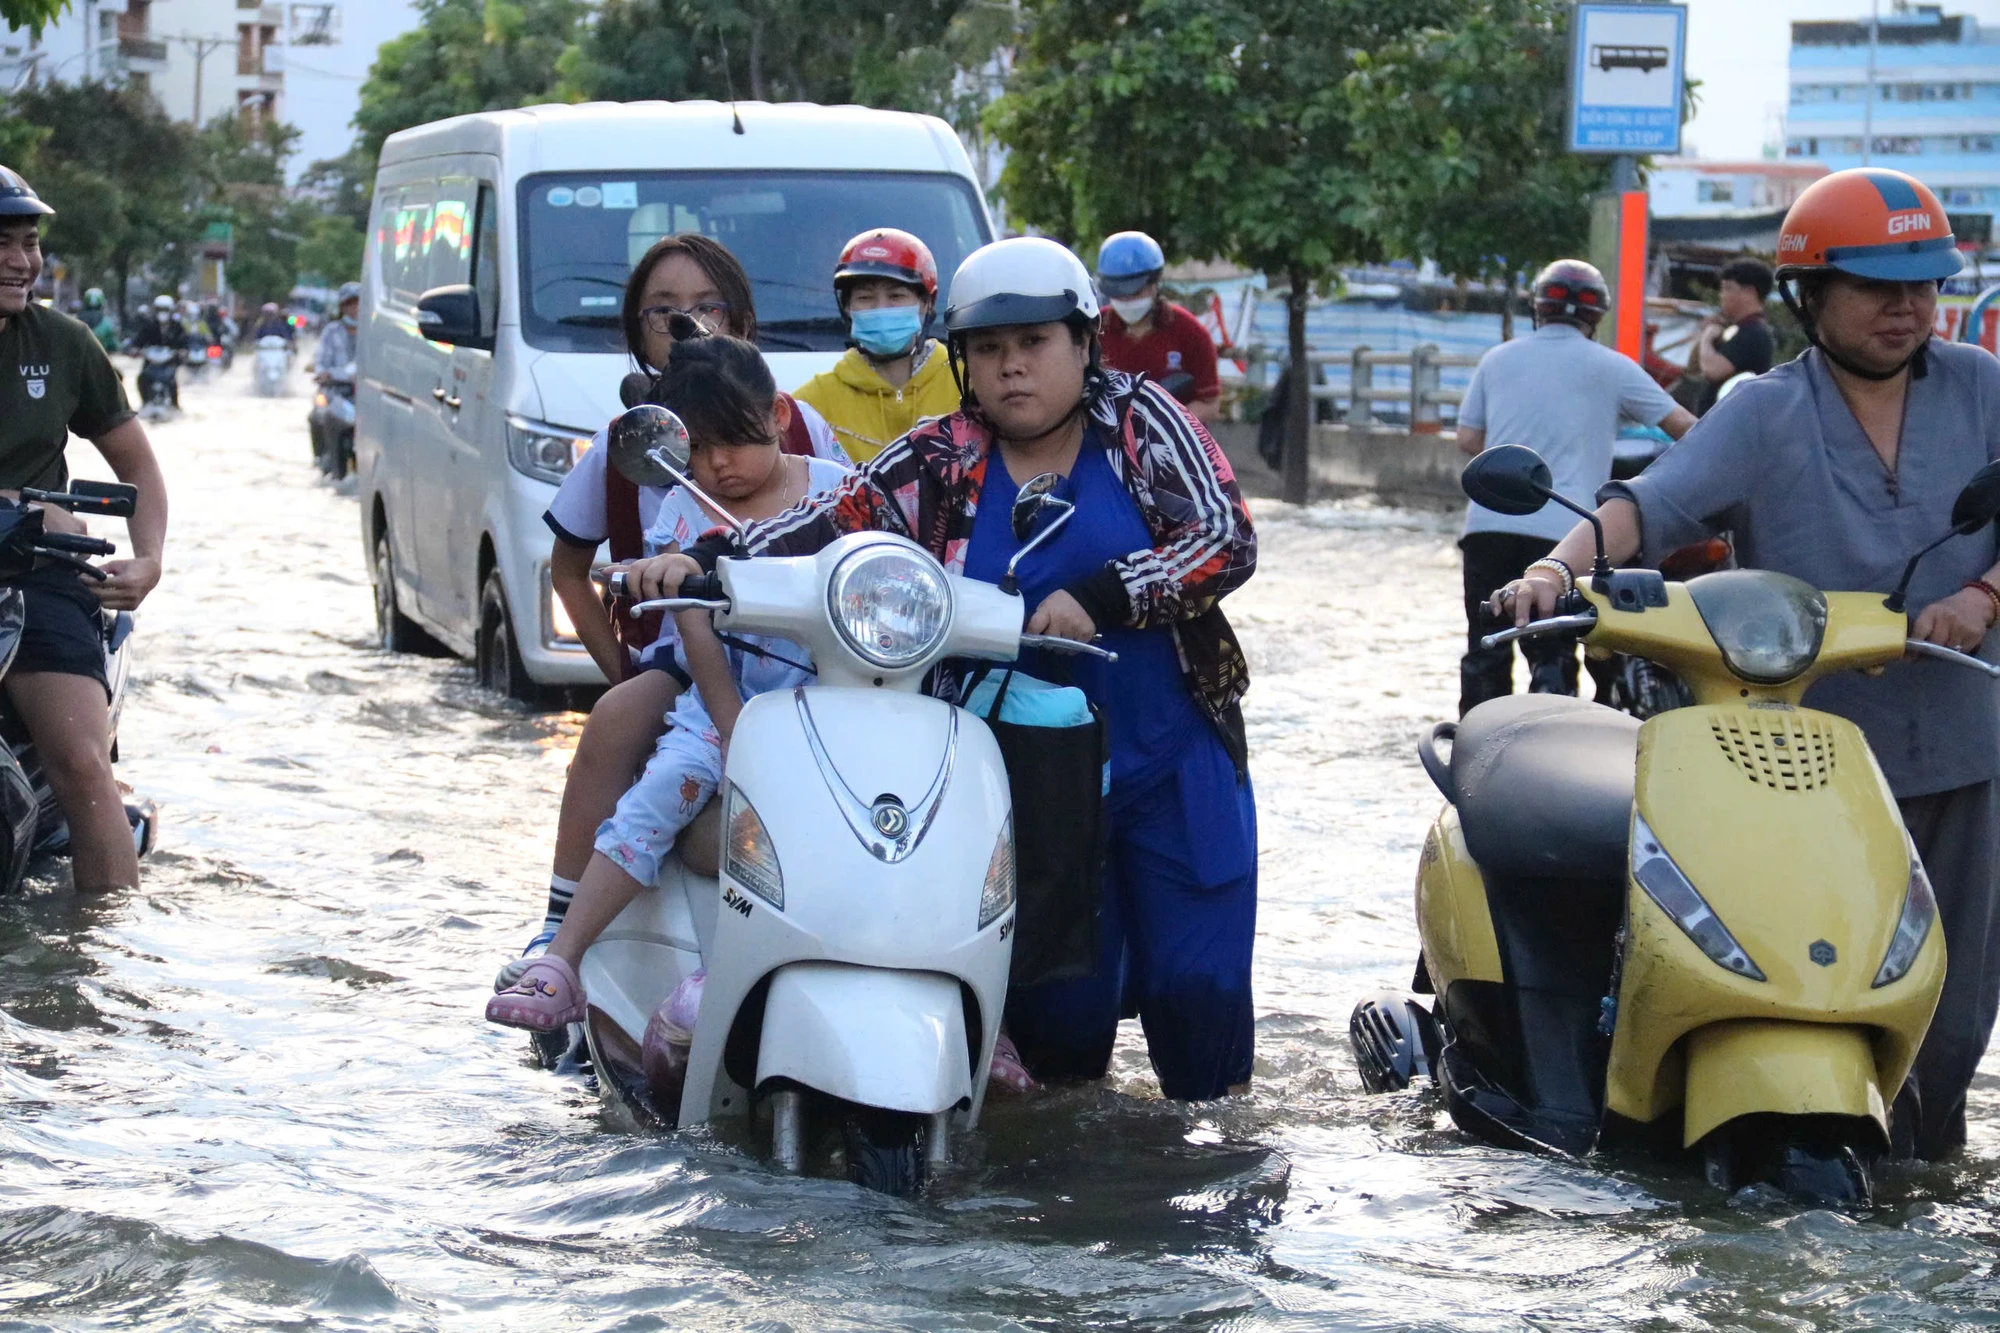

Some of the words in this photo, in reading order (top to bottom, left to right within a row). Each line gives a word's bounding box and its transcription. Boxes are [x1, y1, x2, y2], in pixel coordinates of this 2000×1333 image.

[1888, 213, 1931, 235] GHN
[1780, 233, 1808, 252] GHN
[19, 364, 50, 377] VLU
[722, 887, 754, 918] SYM
